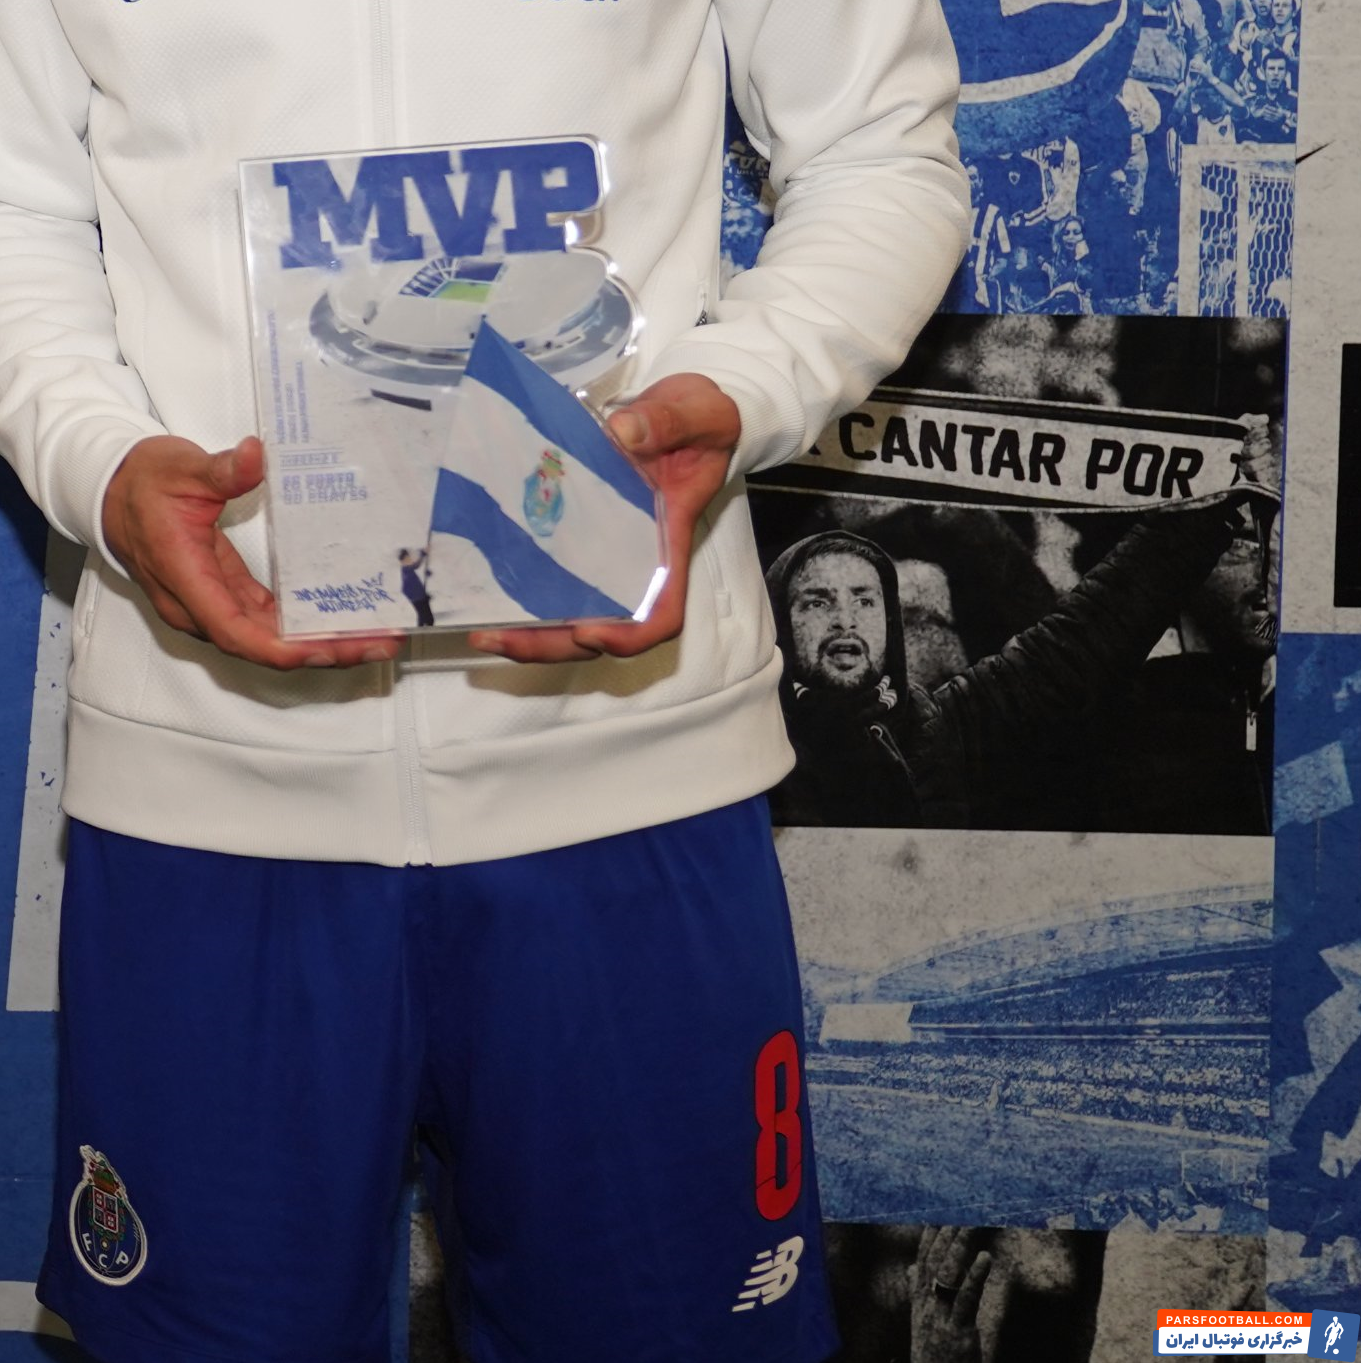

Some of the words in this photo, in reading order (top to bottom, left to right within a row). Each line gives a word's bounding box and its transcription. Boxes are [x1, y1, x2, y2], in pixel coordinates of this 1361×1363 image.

[273, 141, 604, 269] MVP
[838, 412, 1066, 486] CANTAR
[1085, 438, 1204, 499] POR
[754, 1029, 803, 1221] 8
